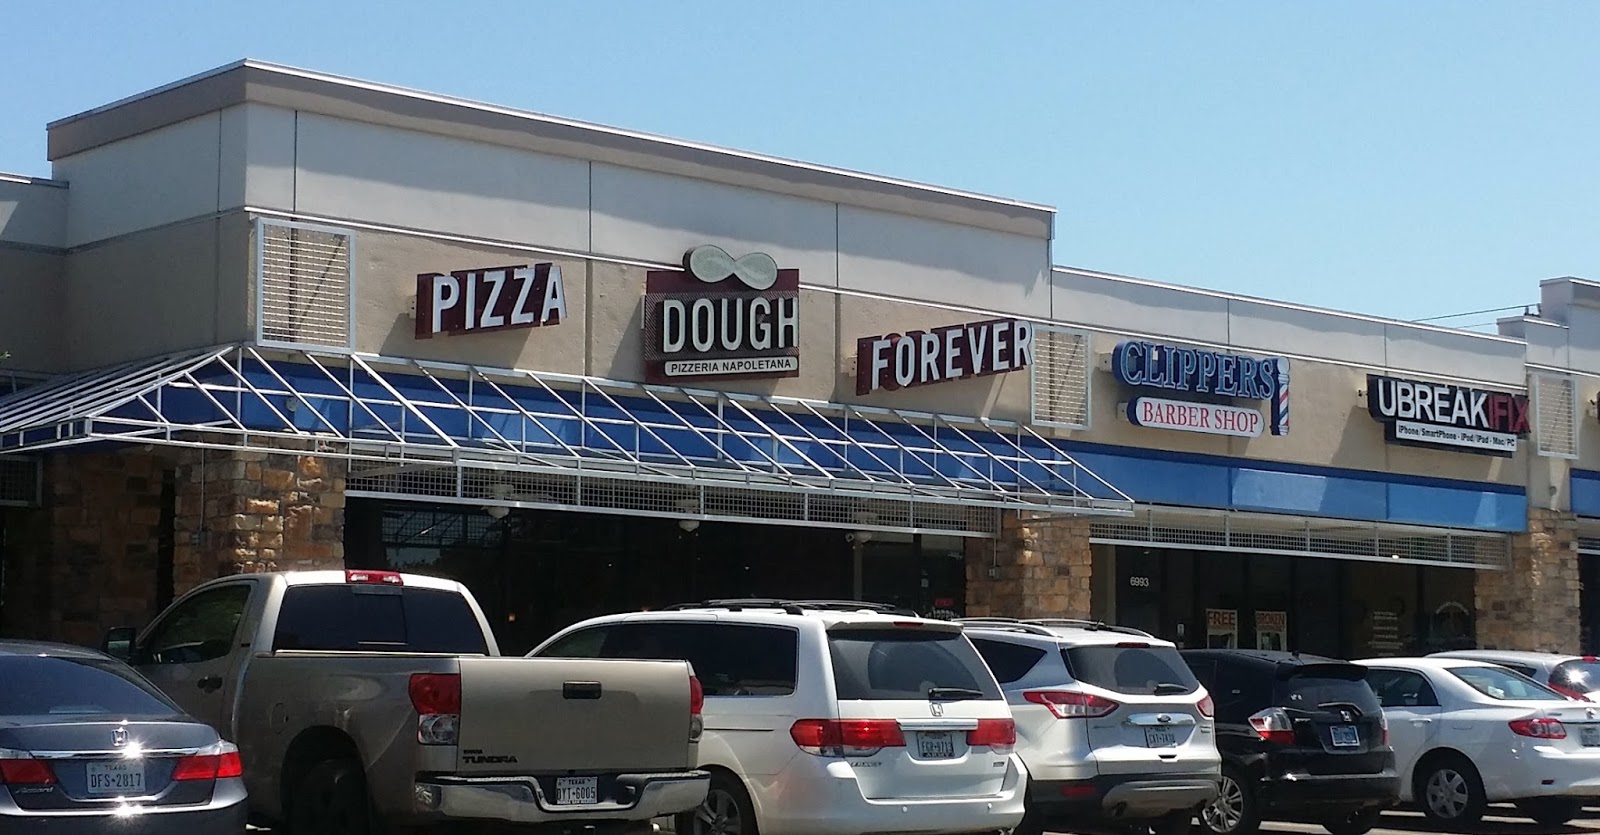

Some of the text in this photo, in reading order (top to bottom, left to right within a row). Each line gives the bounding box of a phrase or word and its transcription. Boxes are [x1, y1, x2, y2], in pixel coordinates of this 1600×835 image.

[432, 265, 567, 334] PIZZA
[663, 297, 799, 353] DOUGH
[671, 359, 792, 373] PIZZERIA NAPOLETANA
[871, 320, 1034, 390] FOREVER
[1119, 340, 1277, 400] CLIPPERS
[1142, 401, 1259, 433] BARBER SHOP
[1130, 576, 1149, 587] 6993
[1207, 611, 1236, 625] FREE
[462, 755, 518, 763] TUNDRA
